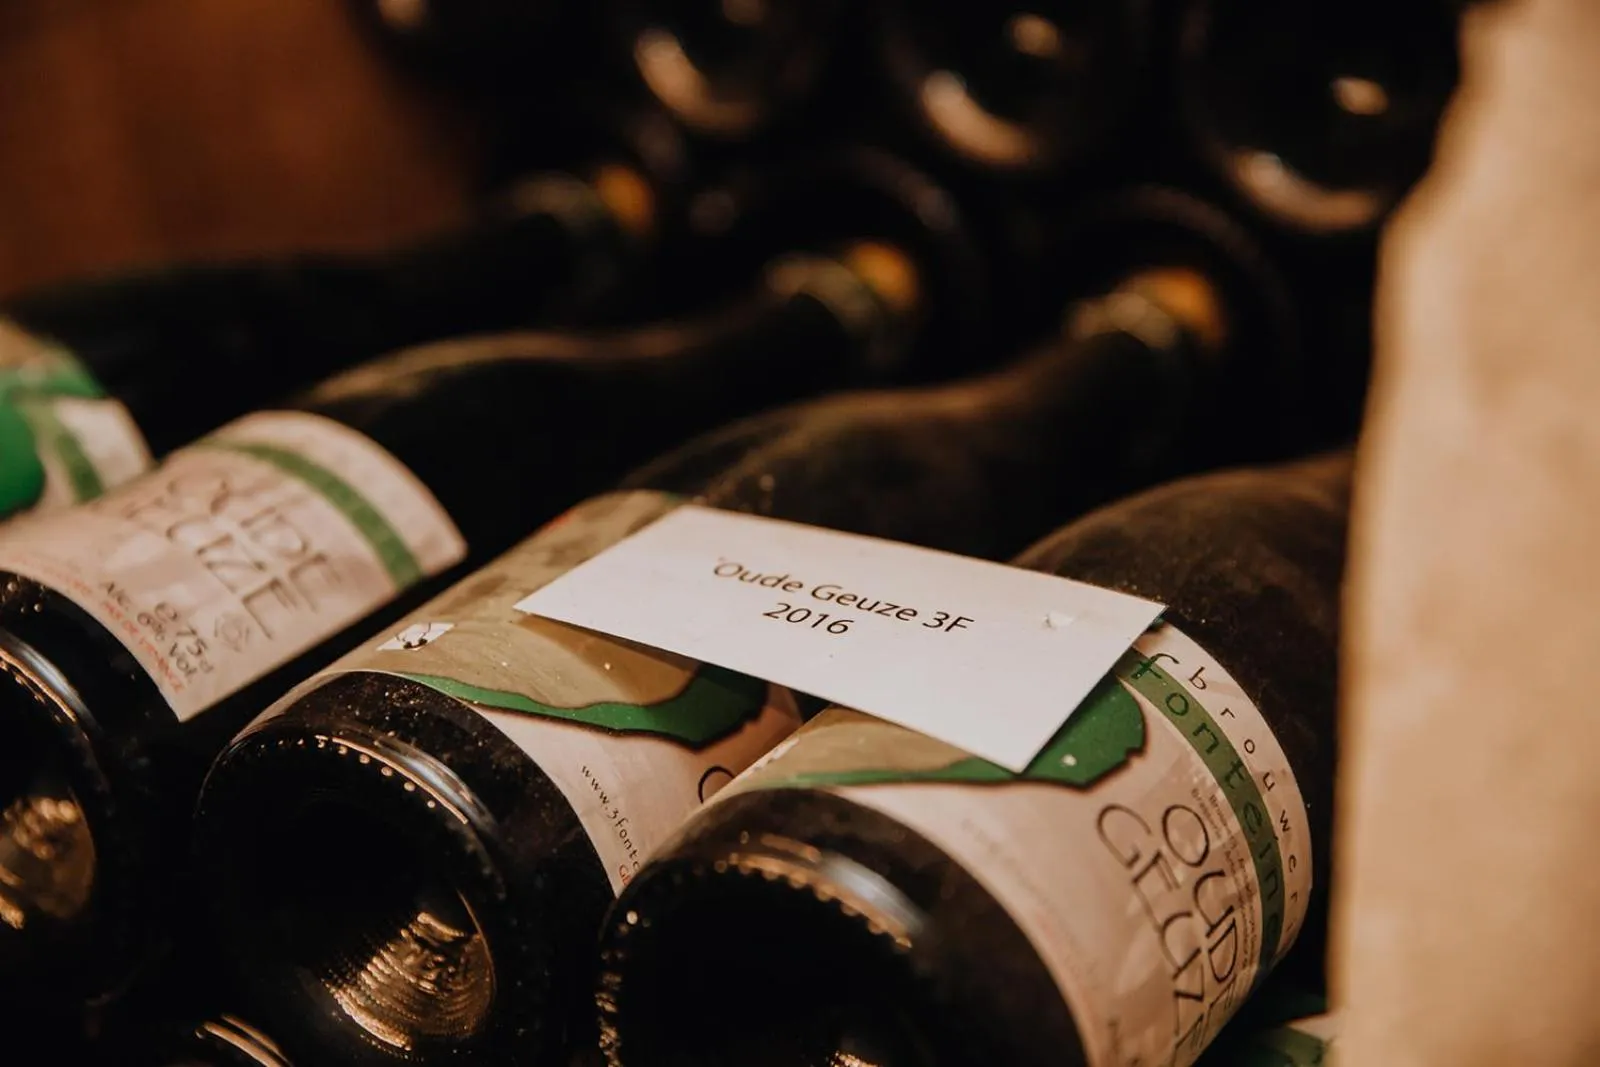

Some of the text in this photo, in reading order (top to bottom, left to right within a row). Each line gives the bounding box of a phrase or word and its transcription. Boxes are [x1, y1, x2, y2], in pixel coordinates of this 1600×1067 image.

[713, 561, 976, 634] Oude Geuze 3F
[762, 601, 855, 635] 2016
[1161, 803, 1239, 1050] OUDE
